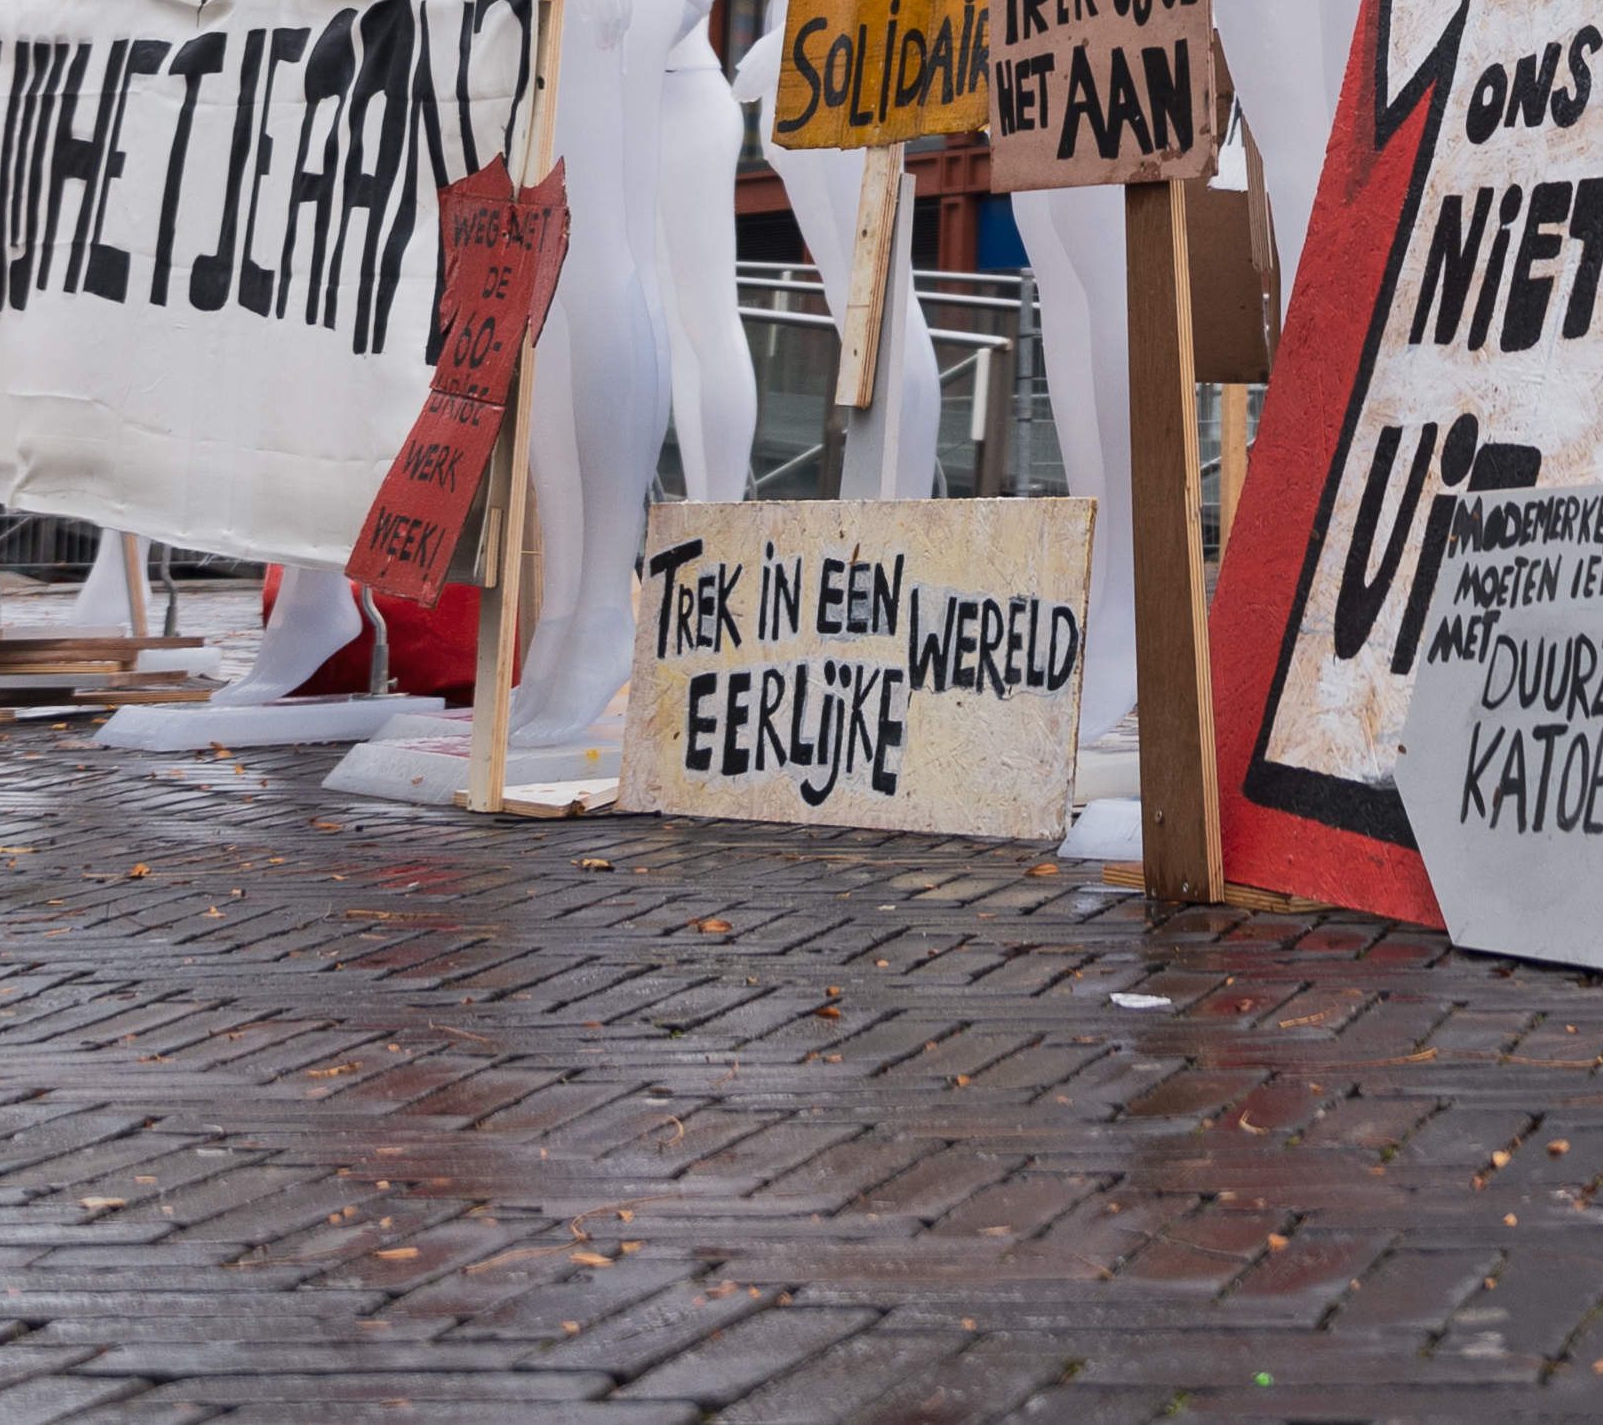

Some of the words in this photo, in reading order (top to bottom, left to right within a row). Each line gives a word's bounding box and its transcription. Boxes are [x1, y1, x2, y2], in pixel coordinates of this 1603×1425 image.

[995, 52, 1055, 137] HET
[1056, 38, 1194, 160] AAN
[1467, 25, 1603, 144] ONS
[482, 266, 512, 299] DE
[403, 439, 465, 493] WERK
[649, 538, 743, 660] TREK
[1453, 553, 1562, 608] MOETEN
[908, 586, 1080, 701] WERELD
[1427, 610, 1501, 665] MET
